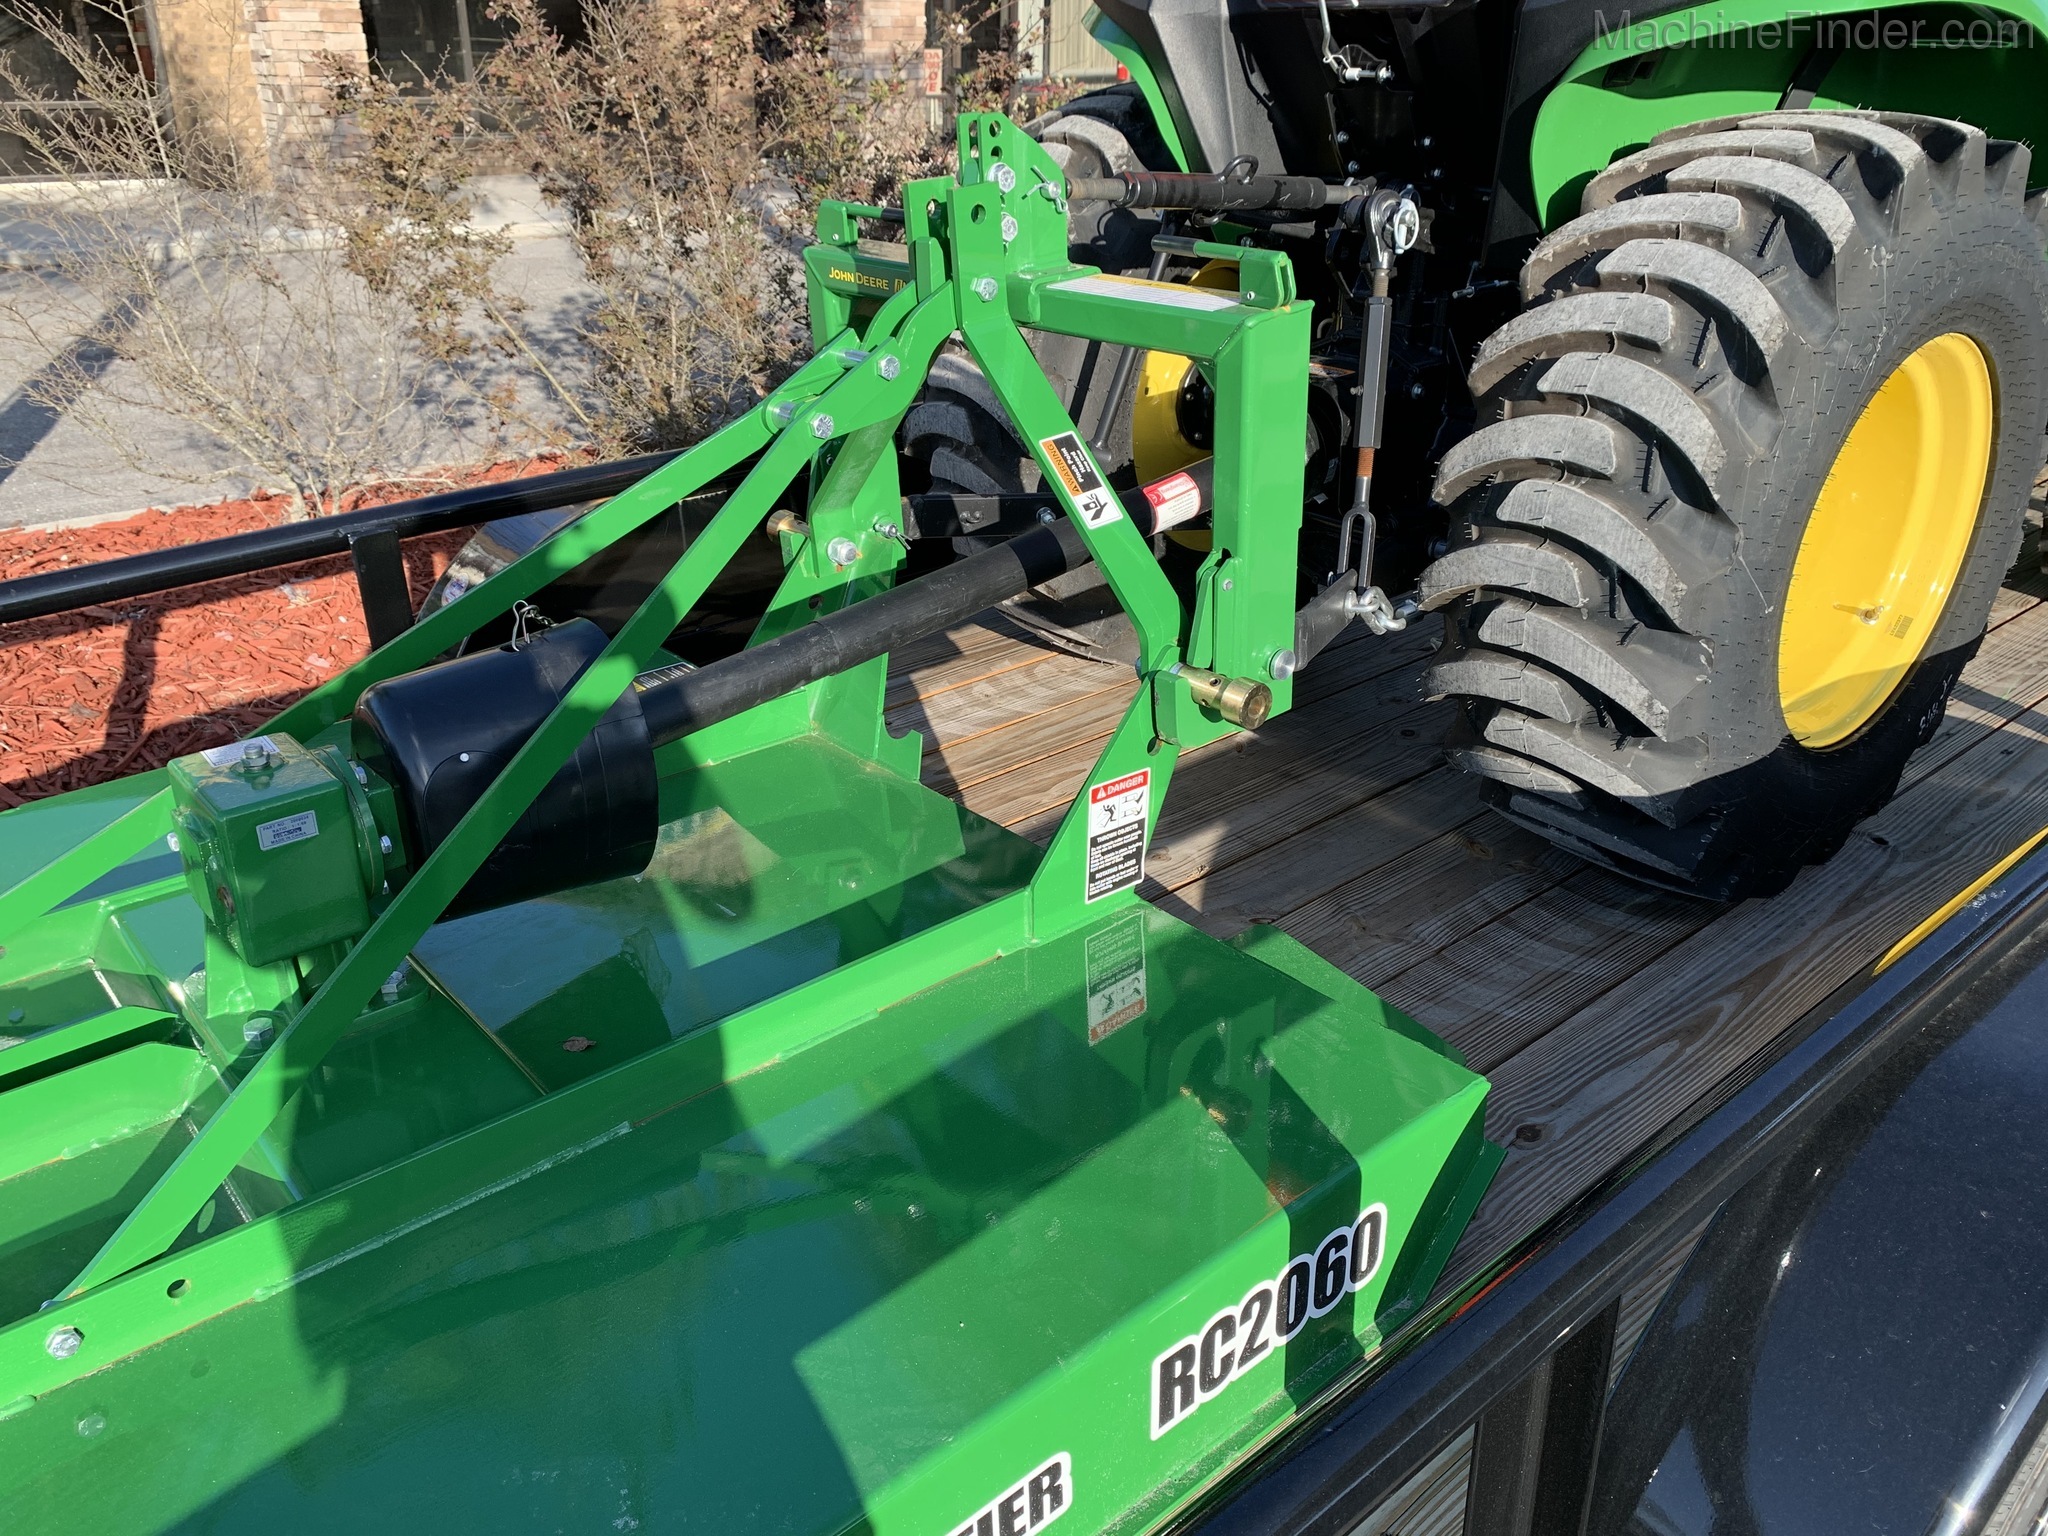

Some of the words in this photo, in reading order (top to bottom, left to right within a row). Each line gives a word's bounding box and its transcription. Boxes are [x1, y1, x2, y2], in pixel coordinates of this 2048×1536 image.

[829, 266, 855, 283] JOHN
[856, 272, 890, 290] DEERE
[1047, 444, 1075, 485] WARNING
[1061, 447, 1072, 465] Point
[1070, 451, 1086, 473] Hazard
[1071, 462, 1084, 482] Pinch
[1107, 775, 1144, 795] DANGER
[1158, 1210, 1382, 1430] RC2060
[957, 1461, 1064, 1536] ER
